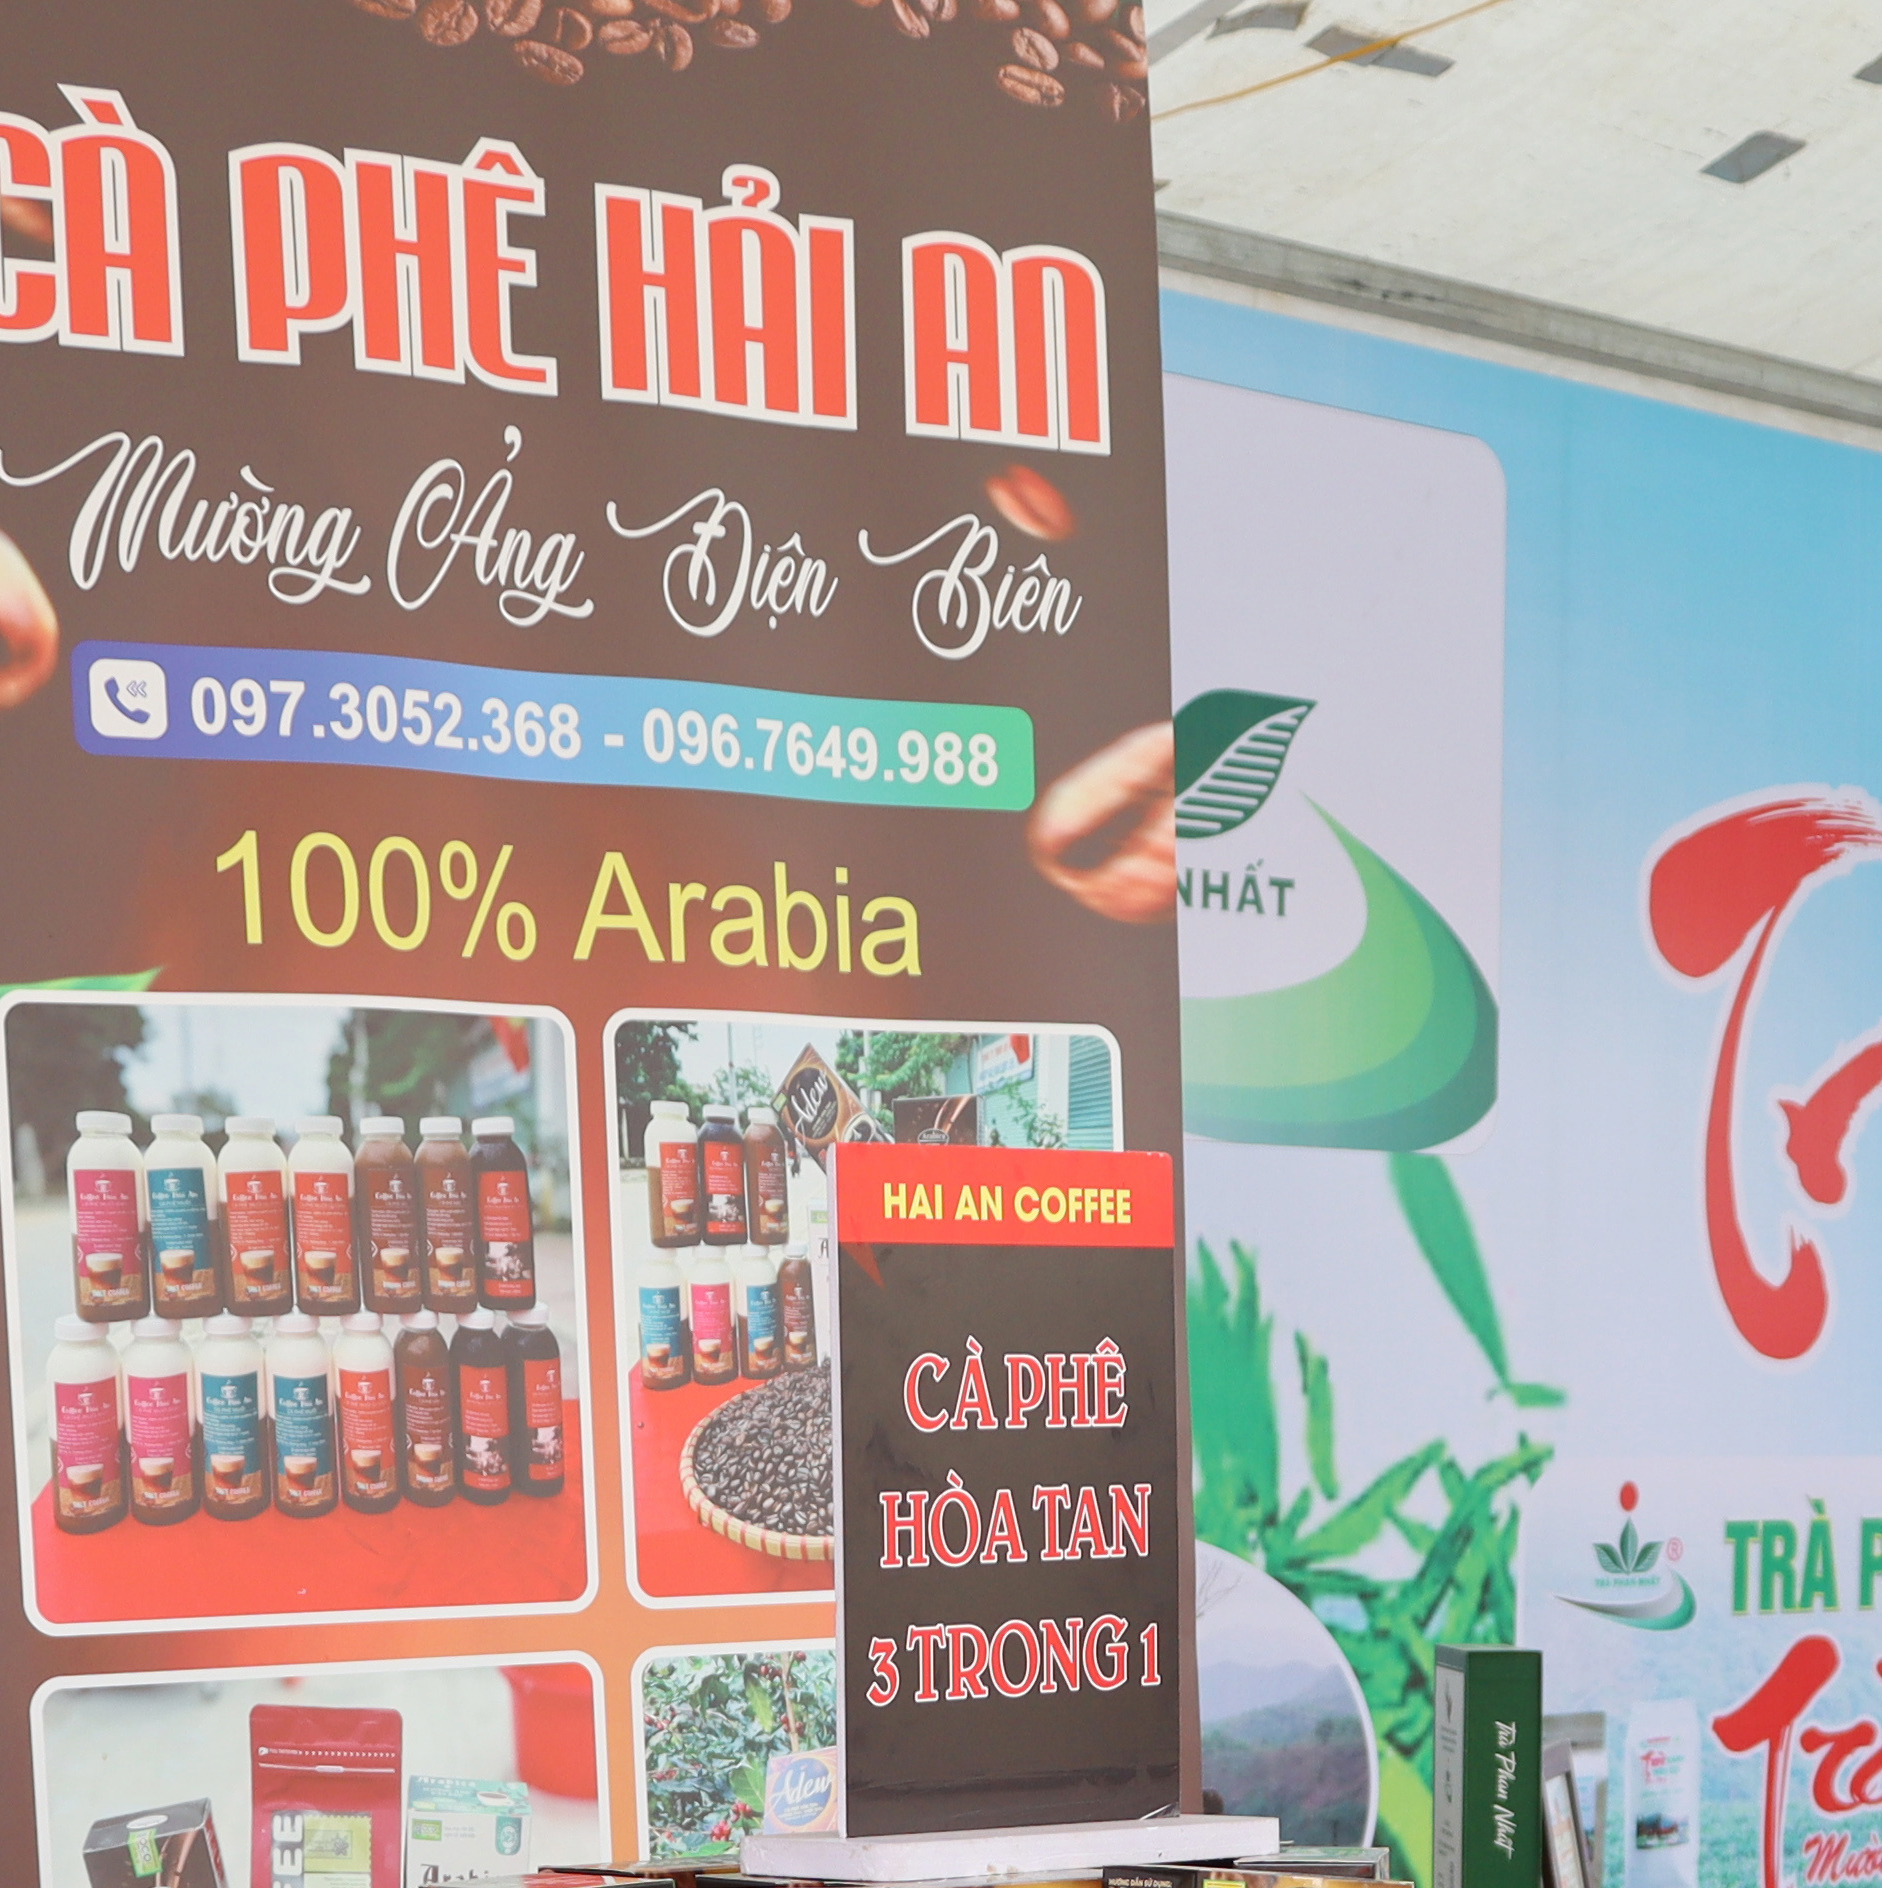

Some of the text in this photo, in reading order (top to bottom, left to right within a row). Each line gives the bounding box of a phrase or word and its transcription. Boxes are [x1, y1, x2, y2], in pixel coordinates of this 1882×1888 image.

[229, 138, 557, 395] PHÊ
[595, 164, 857, 429] HẢI
[902, 231, 1111, 455] AN
[858, 514, 1082, 660] Biên
[190, 675, 999, 787] 097.3052.368 096.7649.988
[213, 829, 923, 977] 100% Arabia
[883, 1183, 1132, 1225] HAI AN COFFEE
[903, 1335, 1129, 1434] CÀ PHÊ
[879, 1469, 1151, 1570] HÒA TAN
[1724, 1494, 1840, 1614] TRÀ
[866, 1614, 1160, 1706] 3 TRONG 1
